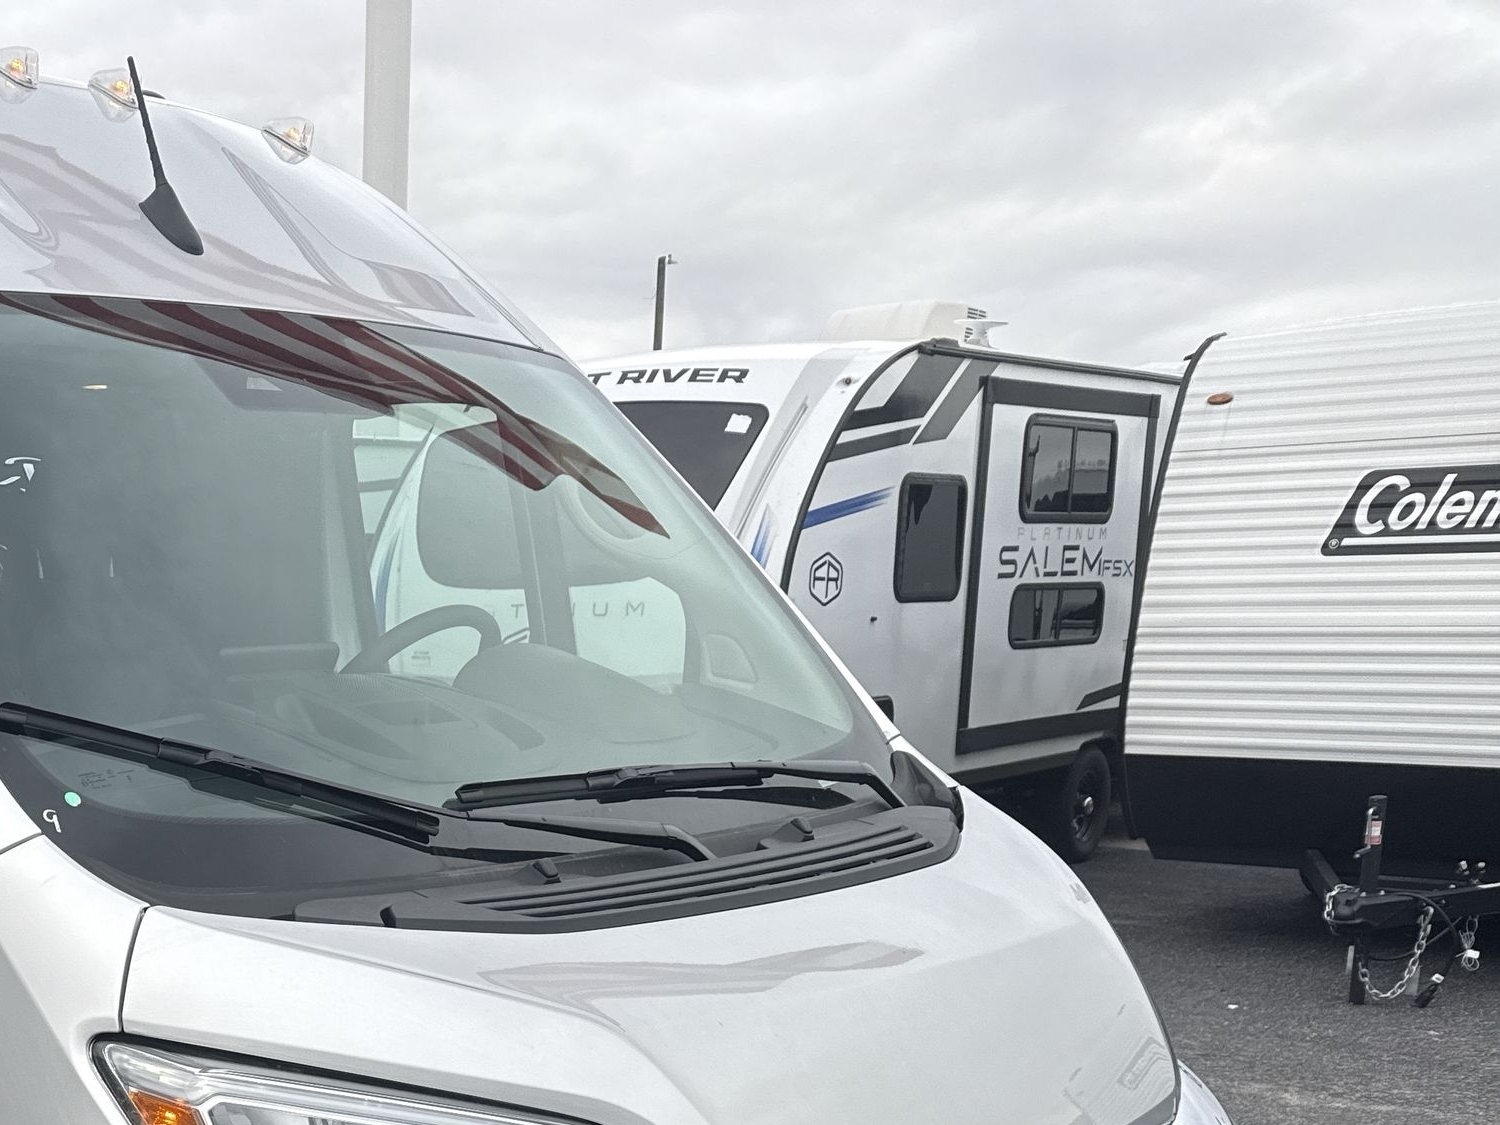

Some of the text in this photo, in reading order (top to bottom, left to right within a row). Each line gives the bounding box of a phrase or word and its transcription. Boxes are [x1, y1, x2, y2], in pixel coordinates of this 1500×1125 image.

[616, 367, 750, 385] RIVER
[1016, 526, 1108, 542] PLATINUM
[997, 544, 1135, 579] SALEM FSX
